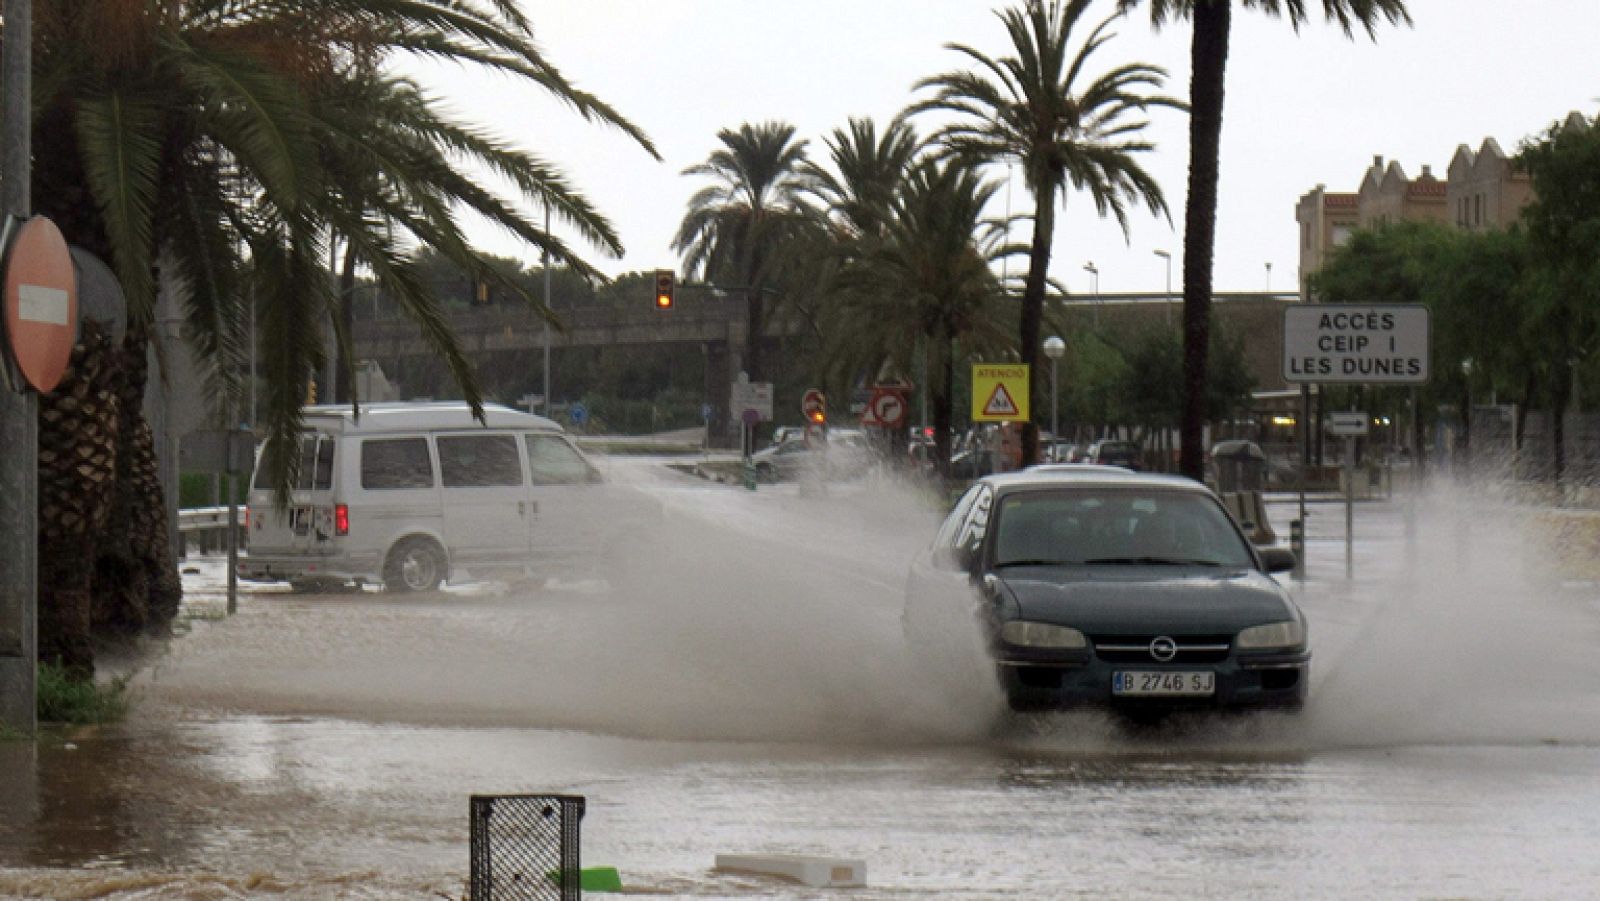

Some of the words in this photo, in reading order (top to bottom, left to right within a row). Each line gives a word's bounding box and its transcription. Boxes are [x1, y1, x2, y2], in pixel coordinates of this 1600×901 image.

[1318, 335, 1369, 353] CEIP
[1388, 335, 1395, 353] I
[1290, 357, 1332, 375] LES
[1342, 357, 1421, 376] DUNES
[1124, 673, 1134, 691] B
[1140, 673, 1184, 691] 2746
[1191, 673, 1214, 691] SJ
